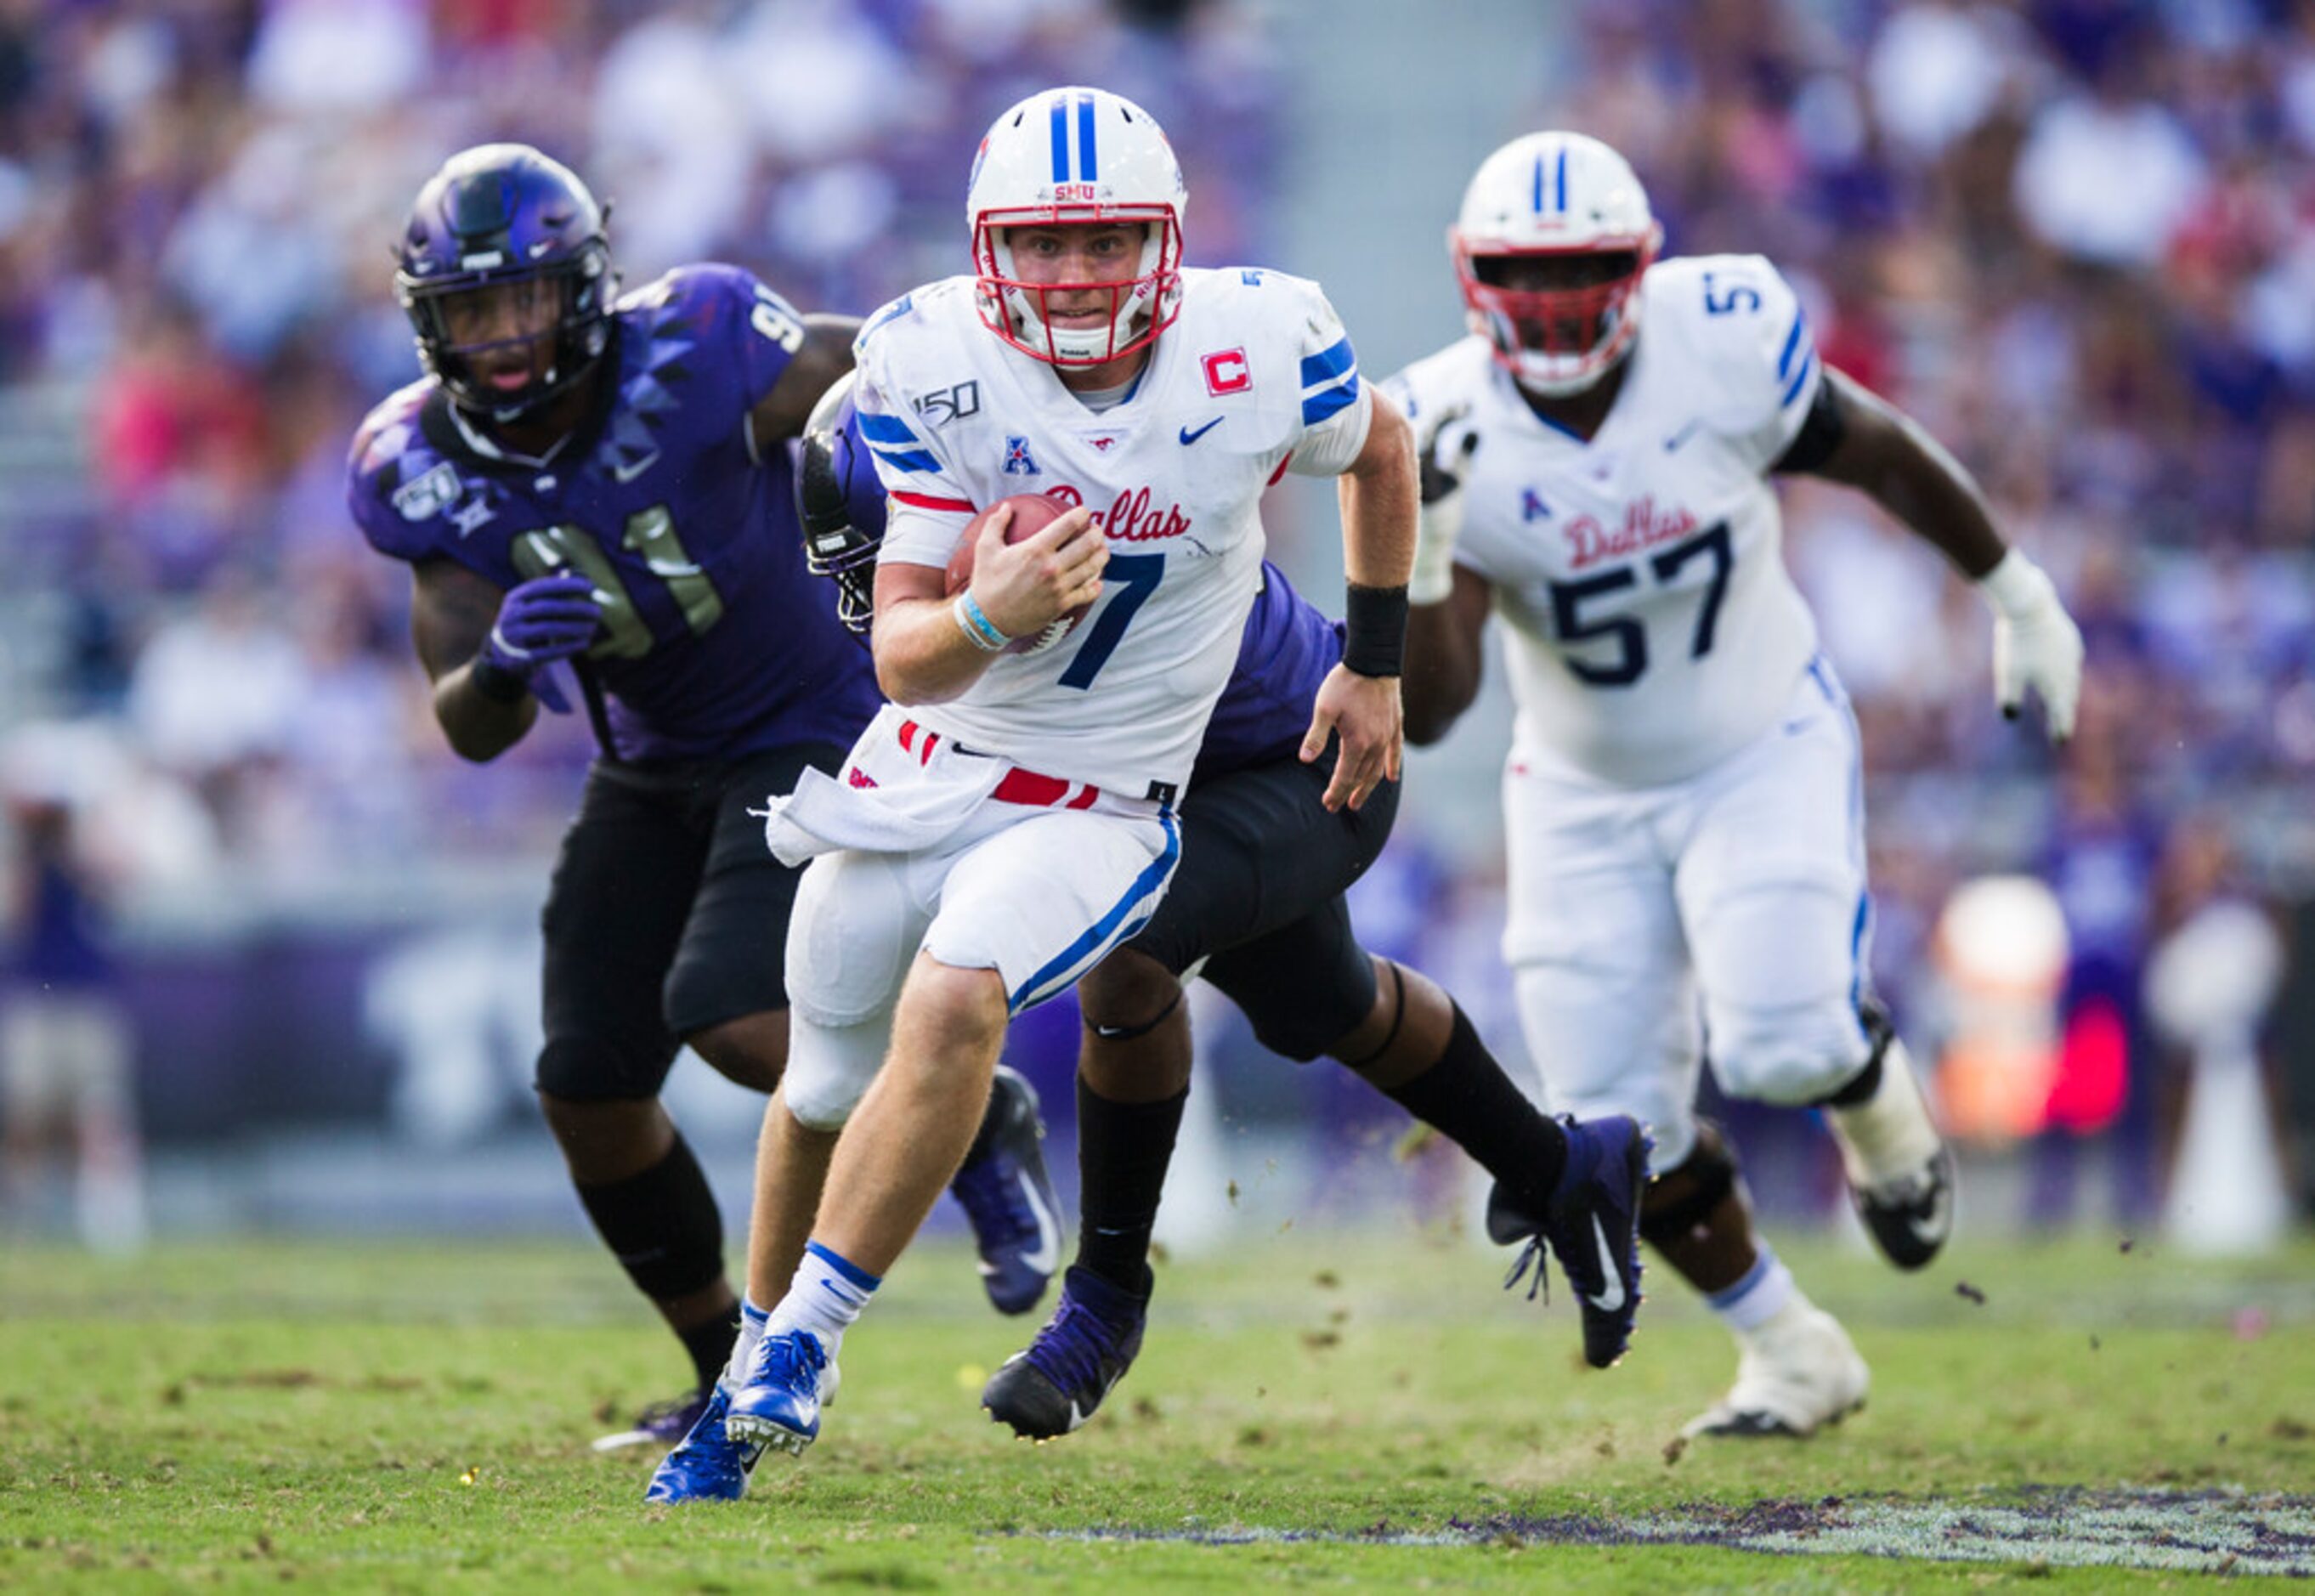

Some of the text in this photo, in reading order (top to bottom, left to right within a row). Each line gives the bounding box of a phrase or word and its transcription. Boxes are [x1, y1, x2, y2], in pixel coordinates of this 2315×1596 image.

[1055, 184, 1095, 201] SMU
[912, 379, 980, 428] 150
[1207, 352, 1248, 392] C
[1563, 493, 1698, 570] Dallas
[1056, 552, 1166, 691] 7
[1548, 519, 1735, 690] 57
